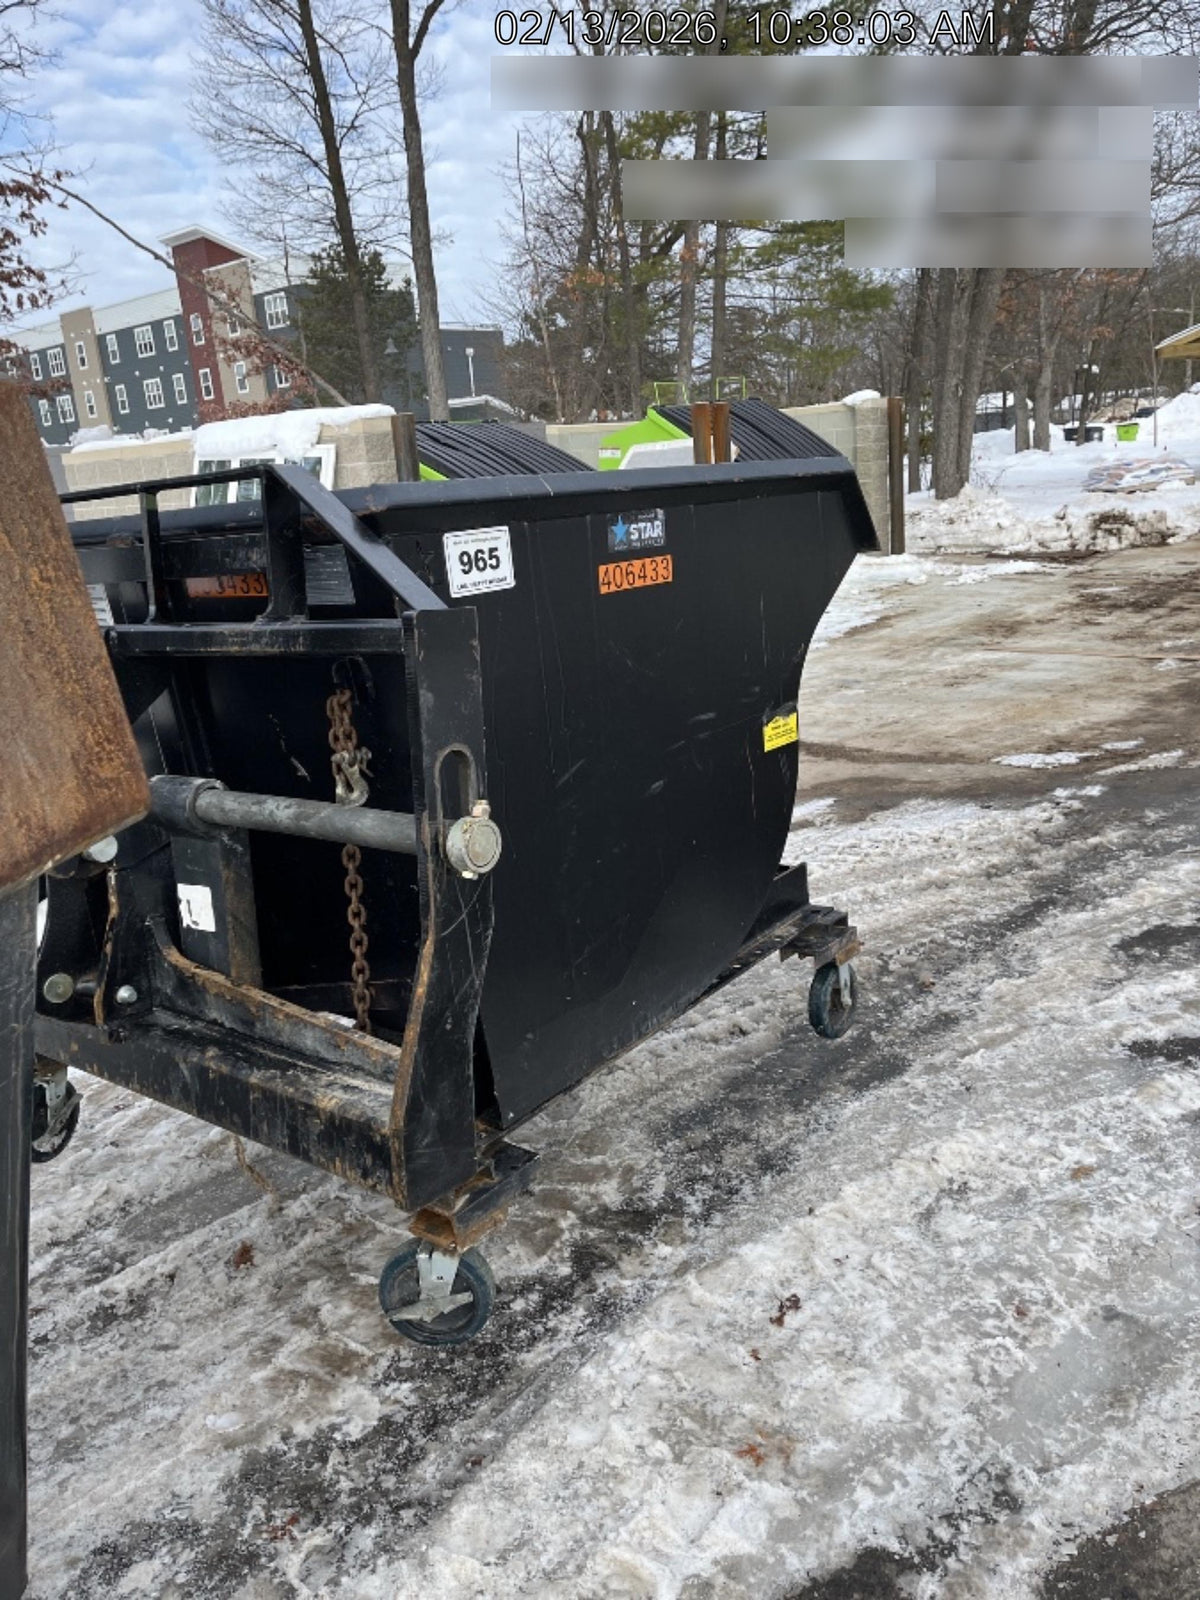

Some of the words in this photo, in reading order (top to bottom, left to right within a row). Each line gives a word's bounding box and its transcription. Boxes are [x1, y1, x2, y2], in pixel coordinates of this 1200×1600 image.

[629, 520, 663, 540] STAR
[458, 547, 501, 575] 965
[601, 557, 671, 590] 406433
